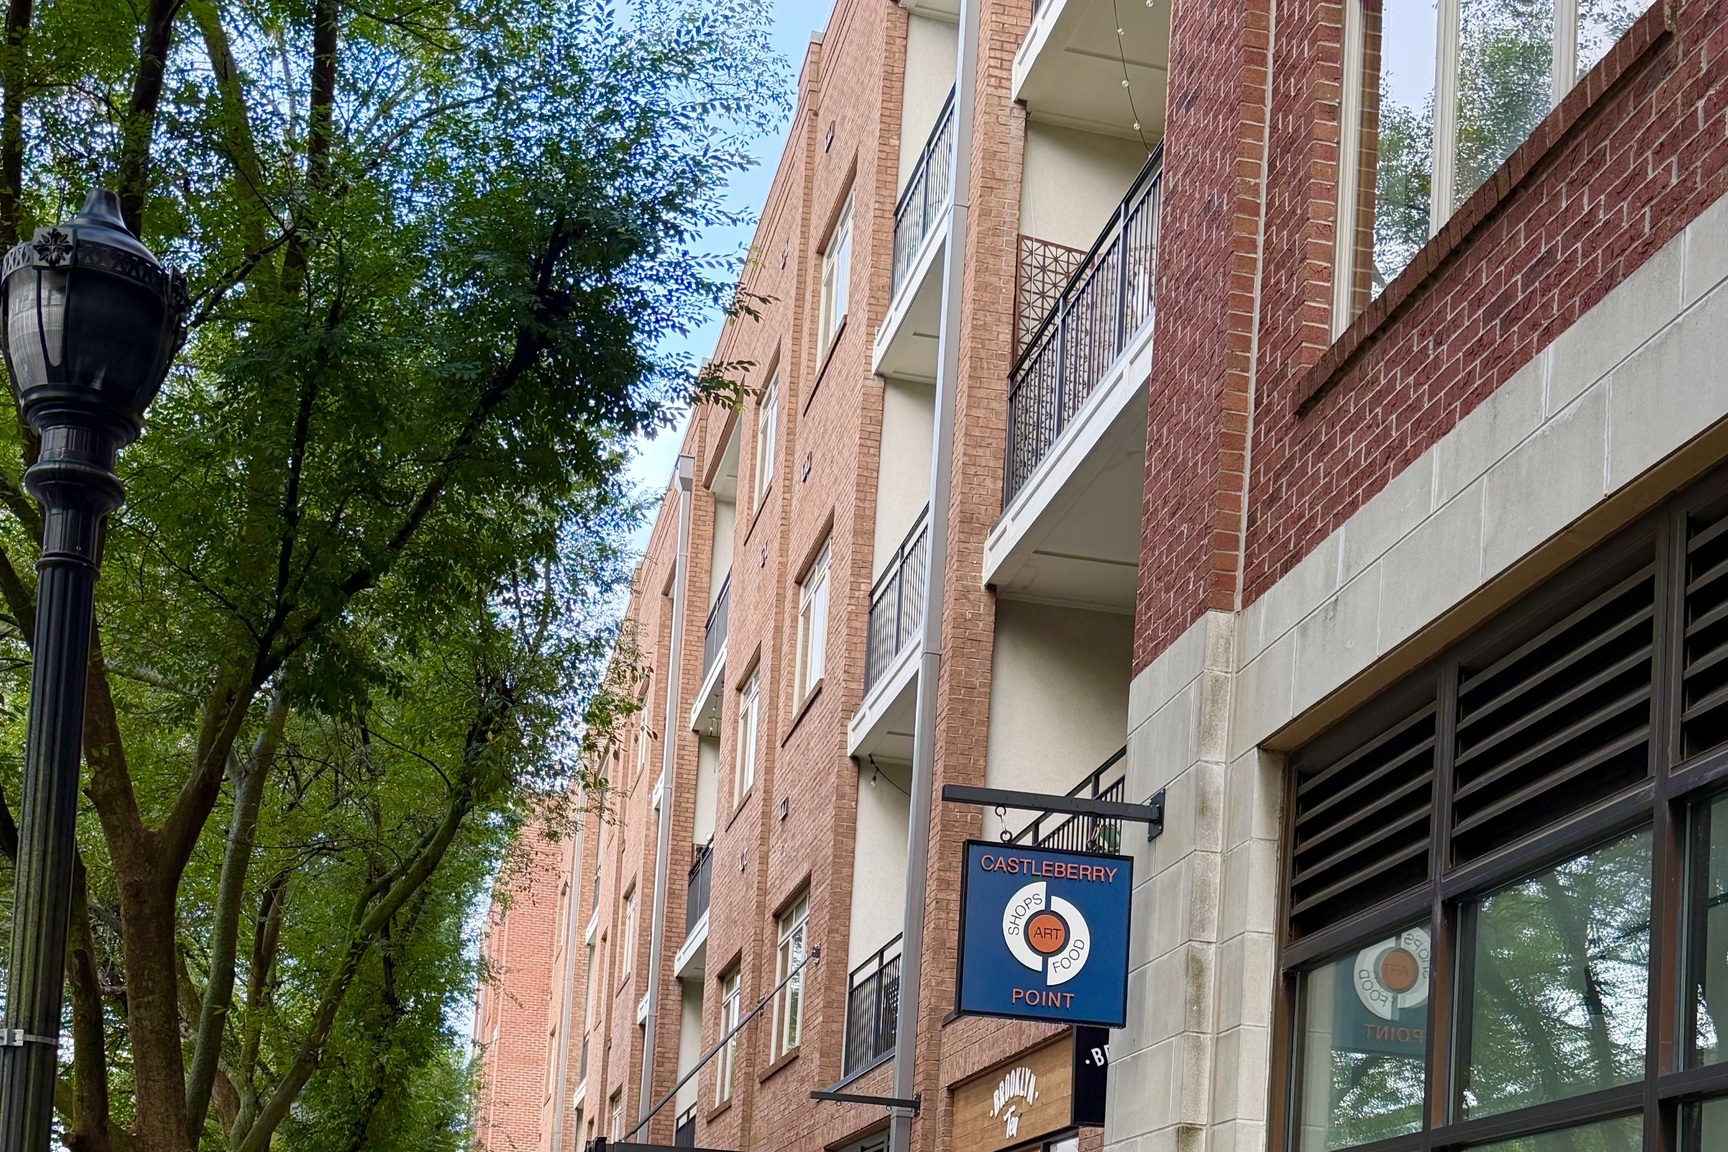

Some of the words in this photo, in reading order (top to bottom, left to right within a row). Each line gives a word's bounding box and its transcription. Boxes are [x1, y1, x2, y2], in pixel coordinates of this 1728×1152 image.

[980, 855, 1118, 883] CASTLEBERRY
[1008, 893, 1043, 936] SHOPS
[1033, 926, 1062, 940] ART
[1052, 938, 1085, 974] FOOD
[1012, 988, 1074, 1009] POINT
[993, 1066, 1036, 1118] BROOKLYN
